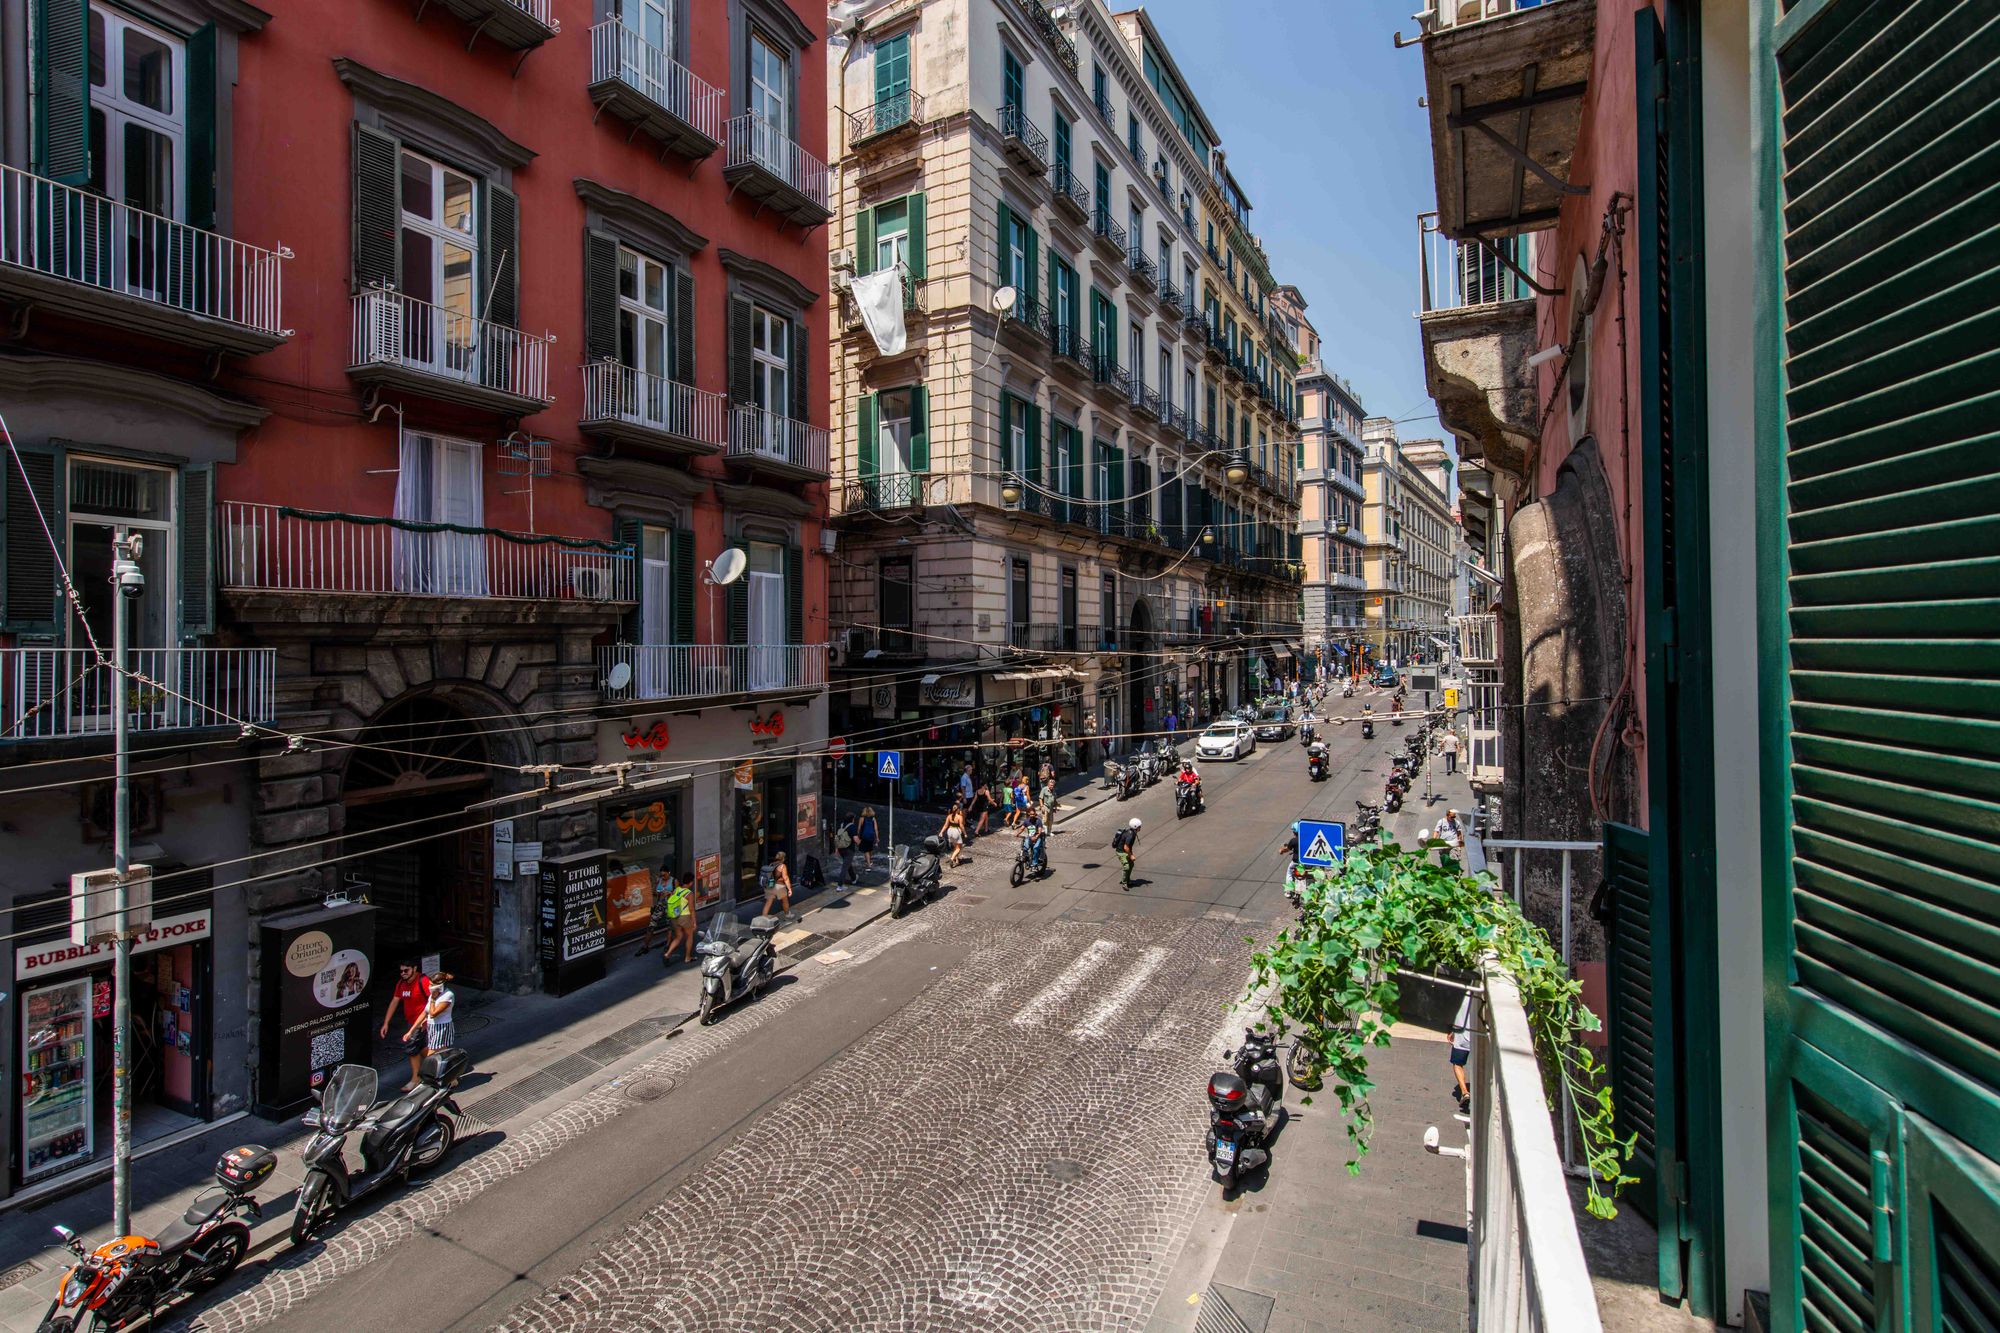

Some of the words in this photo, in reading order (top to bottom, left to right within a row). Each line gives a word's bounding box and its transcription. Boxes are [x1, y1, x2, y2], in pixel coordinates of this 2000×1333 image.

[623, 833, 661, 849] WINDTRE
[568, 864, 600, 881] ETTORE
[565, 876, 602, 894] ORIUNDO
[564, 895, 580, 904] HAIR
[581, 888, 603, 899] SALON
[571, 927, 605, 944] INTERNO
[25, 943, 101, 969] BUBBLE
[162, 920, 206, 938] POKE
[296, 940, 323, 952] Ettore
[571, 937, 605, 954] PALAZZO
[291, 947, 328, 960] Oriundo
[284, 1022, 309, 1035] INTERNO
[310, 1013, 334, 1026] PALAZZO
[335, 1007, 353, 1018] PIANO
[353, 1002, 370, 1011] TERRA
